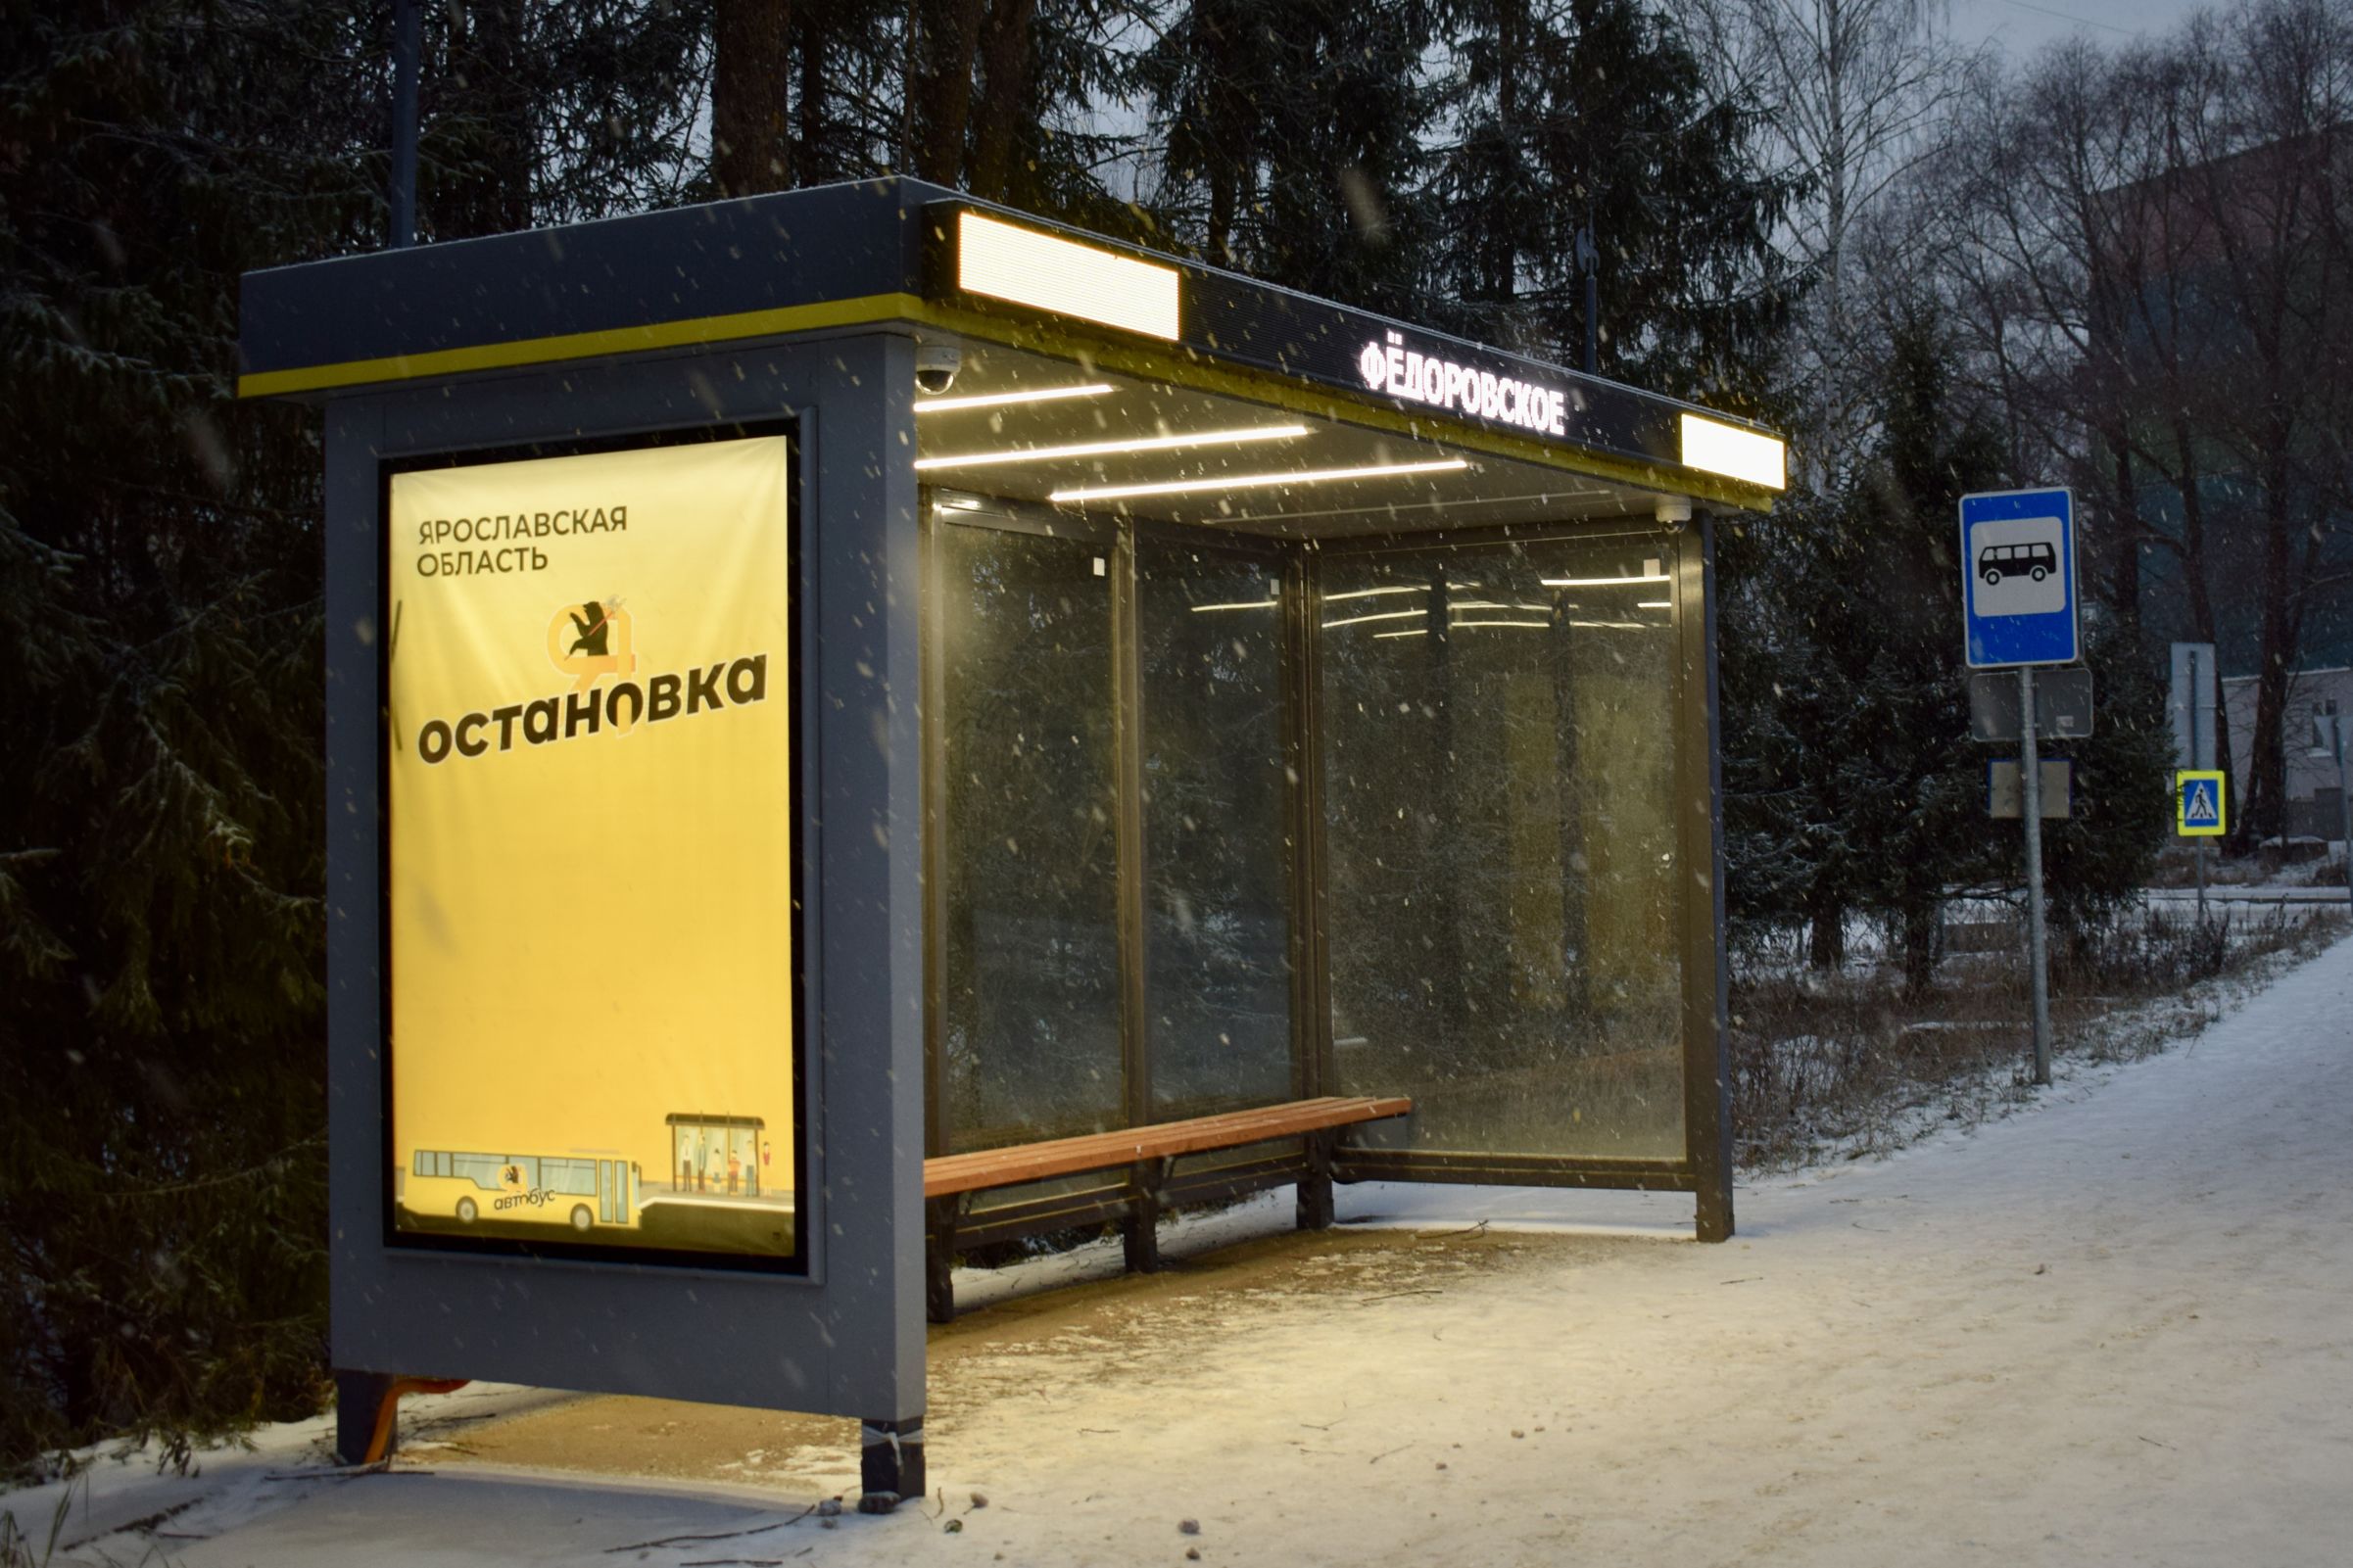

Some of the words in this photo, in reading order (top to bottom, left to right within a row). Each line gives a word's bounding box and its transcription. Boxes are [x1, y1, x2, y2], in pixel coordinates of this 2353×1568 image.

[1360, 330, 1564, 436] ФЁДОРОВСКОЕ
[418, 505, 628, 545] ЯРОСЛАВСКАЯ
[416, 546, 549, 578] ОБЛАСТЬ
[418, 653, 767, 764] остановка
